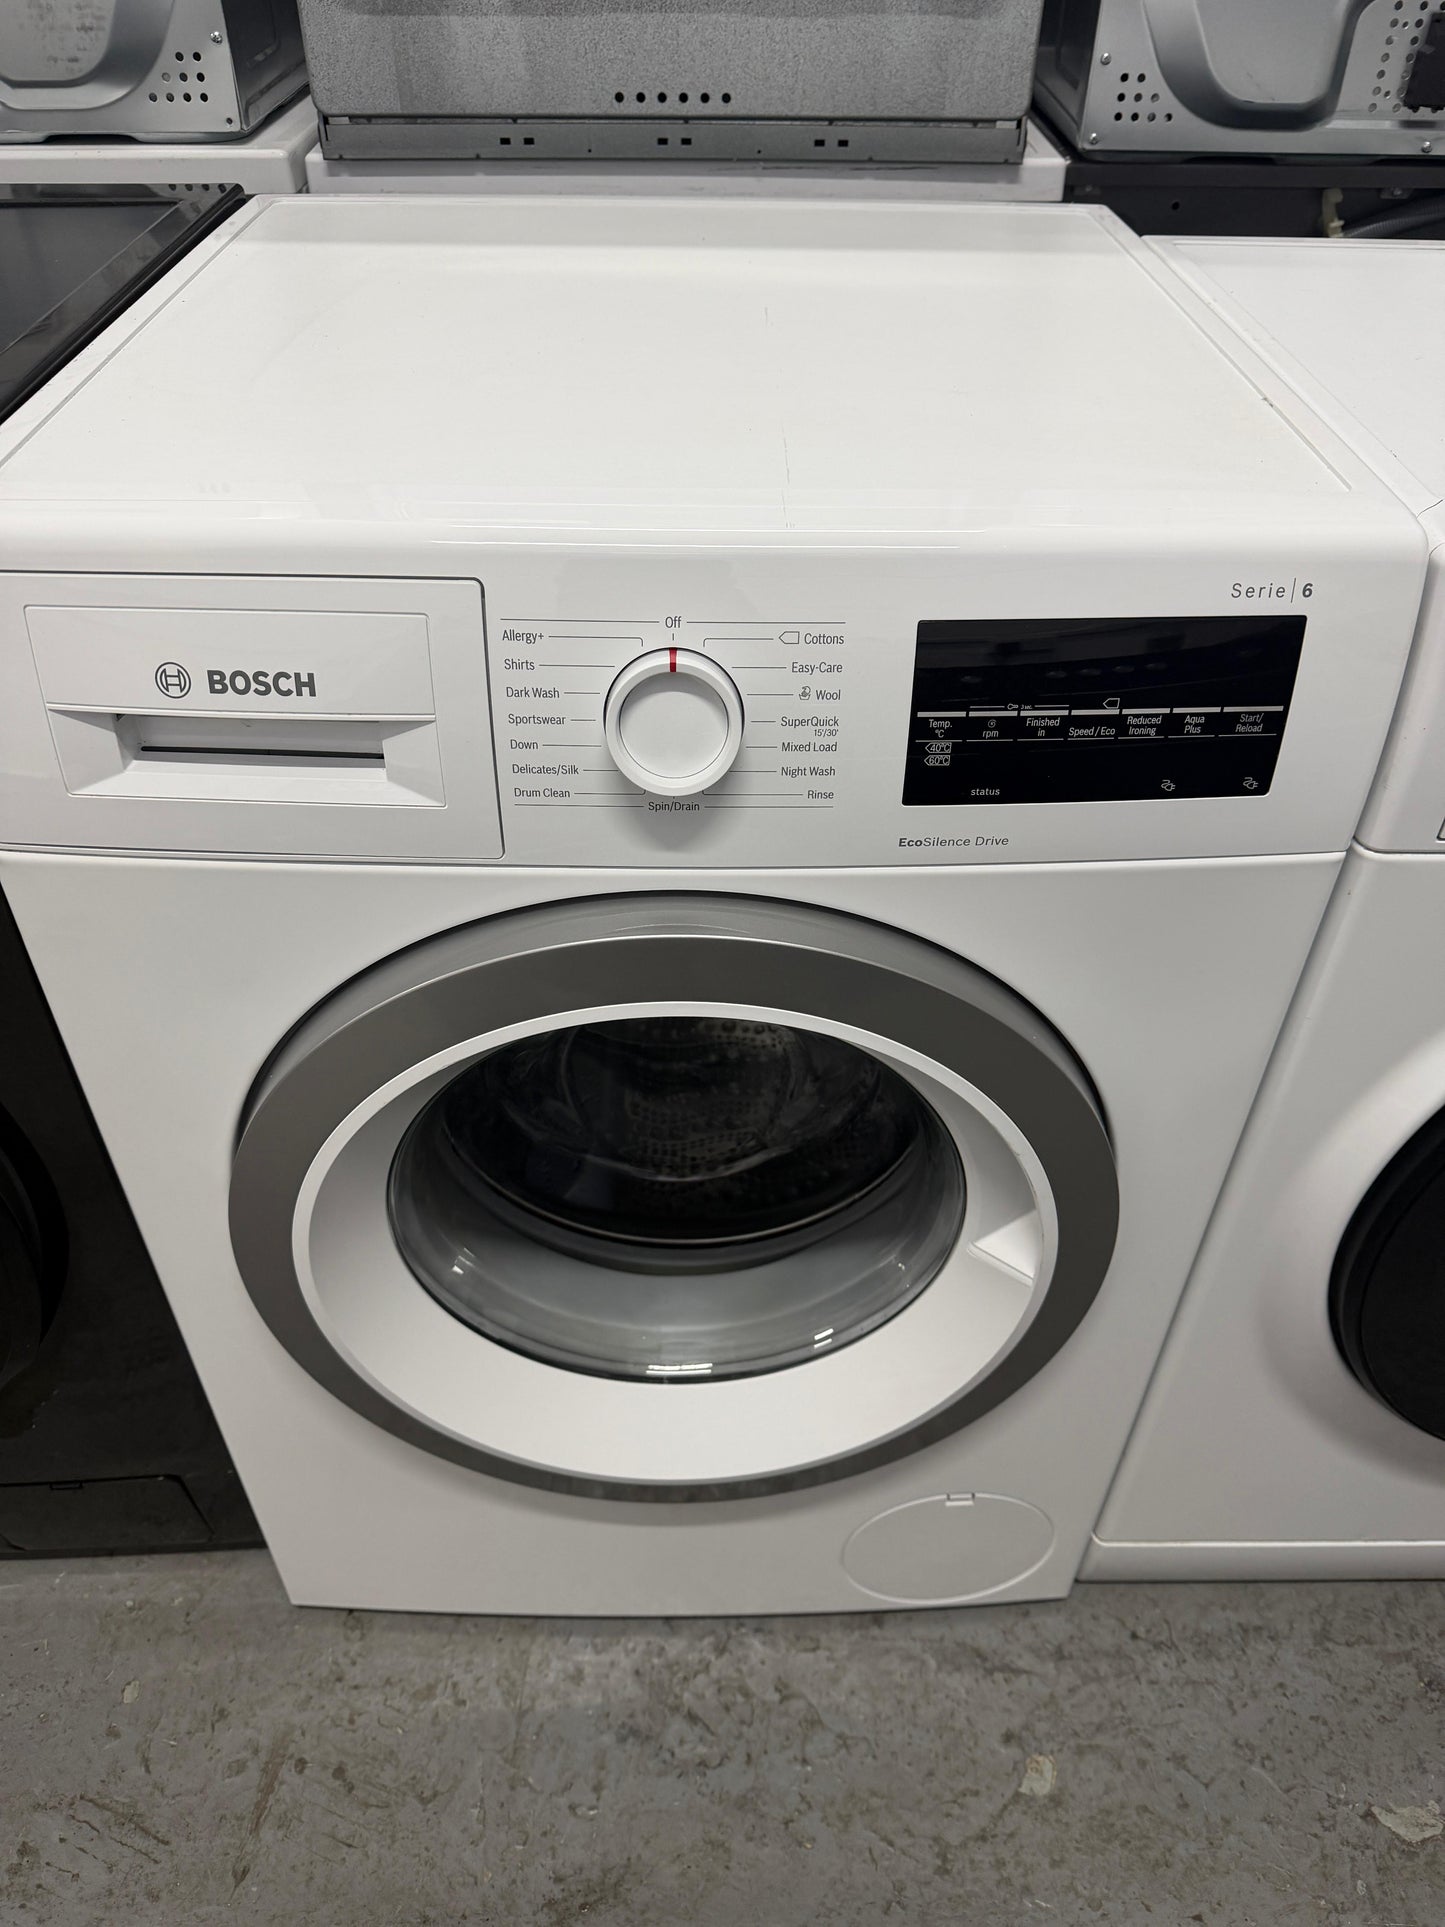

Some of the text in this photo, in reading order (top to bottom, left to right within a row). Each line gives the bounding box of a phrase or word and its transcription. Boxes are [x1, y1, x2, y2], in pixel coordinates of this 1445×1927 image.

[1231, 582, 1314, 599] Serie 6
[665, 616, 682, 628] Off
[502, 629, 544, 644] Allergy+
[804, 633, 845, 645] Cottons
[504, 658, 535, 671] Shirts
[791, 661, 843, 675] Easy-Care
[206, 669, 317, 698] BOSCH
[506, 686, 560, 699] Dark Wash
[815, 689, 841, 701] Wool
[508, 713, 566, 726] Sportswear
[780, 715, 839, 729] SuperQuick
[928, 718, 953, 729] Temp.
[1026, 717, 1060, 727] Finished
[1126, 714, 1162, 725] Reduced
[1184, 714, 1205, 725] Aqua
[1239, 713, 1264, 723] Start/
[934, 729, 945, 738] °C
[1037, 727, 1046, 737] in
[1068, 726, 1095, 738] Speed
[1100, 726, 1116, 736] Eco
[1128, 725, 1157, 737] Ironing
[1184, 724, 1202, 734] Plus
[1235, 723, 1263, 733] Reload
[982, 730, 999, 739] rpm
[510, 739, 539, 750] Down
[781, 741, 838, 752] Mixed Load
[930, 743, 951, 753] 40°C
[928, 756, 950, 765] 60°C
[512, 763, 579, 776] Delicates/Silk
[781, 766, 836, 778] Night Wash
[514, 787, 571, 798] Drum Clean
[807, 789, 834, 799] Rinse
[970, 787, 1000, 796] status
[648, 801, 700, 812] Spin/Drain
[898, 835, 1009, 848] EcoSilence Drive
